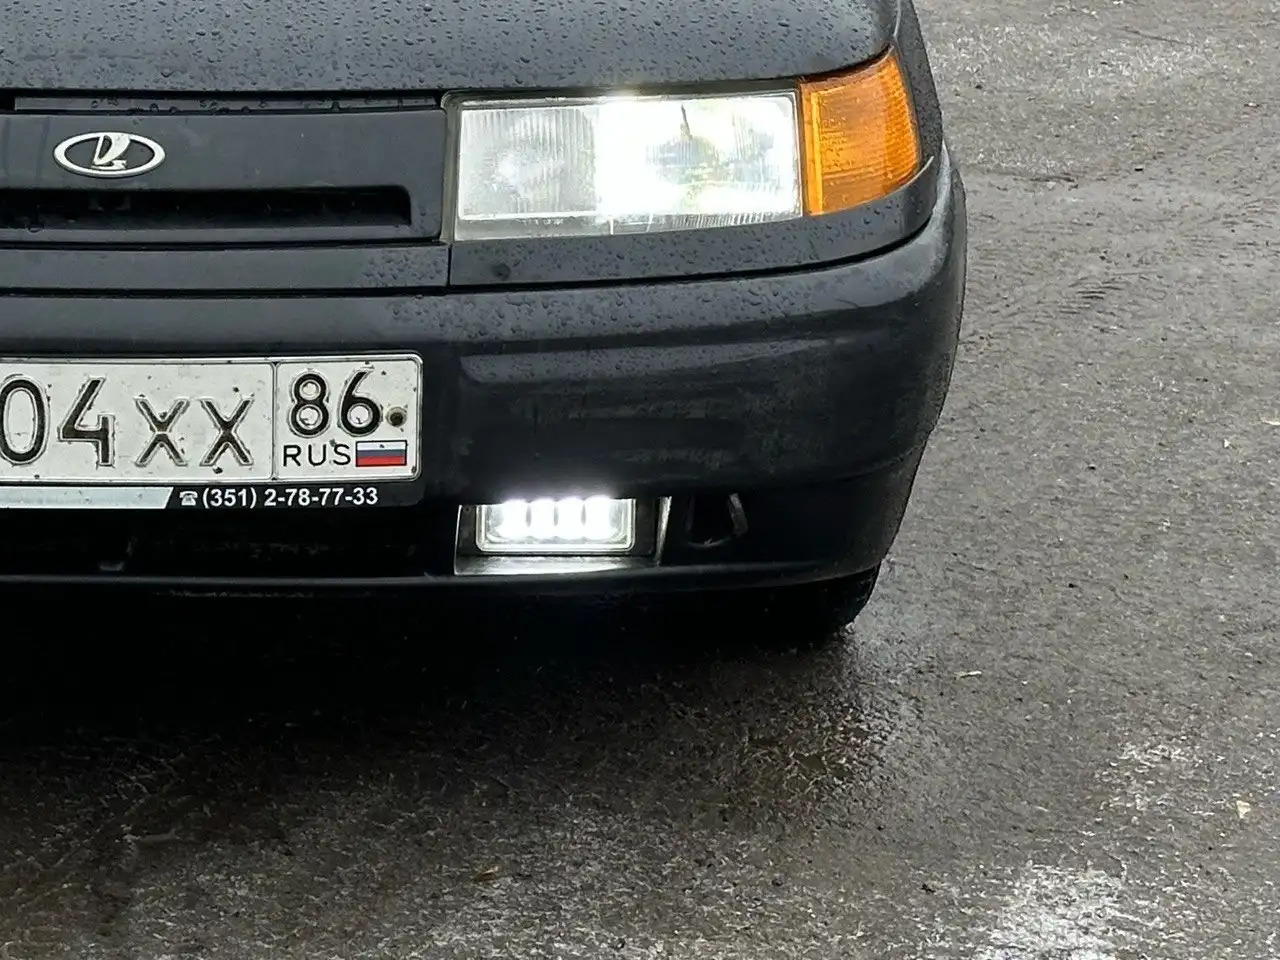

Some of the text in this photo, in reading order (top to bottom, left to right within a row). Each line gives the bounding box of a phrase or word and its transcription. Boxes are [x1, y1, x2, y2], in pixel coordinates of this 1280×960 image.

[288, 371, 382, 437] 86
[282, 444, 352, 467] RUS
[202, 487, 258, 509] (351)
[264, 487, 379, 507] 2-78-77-33
